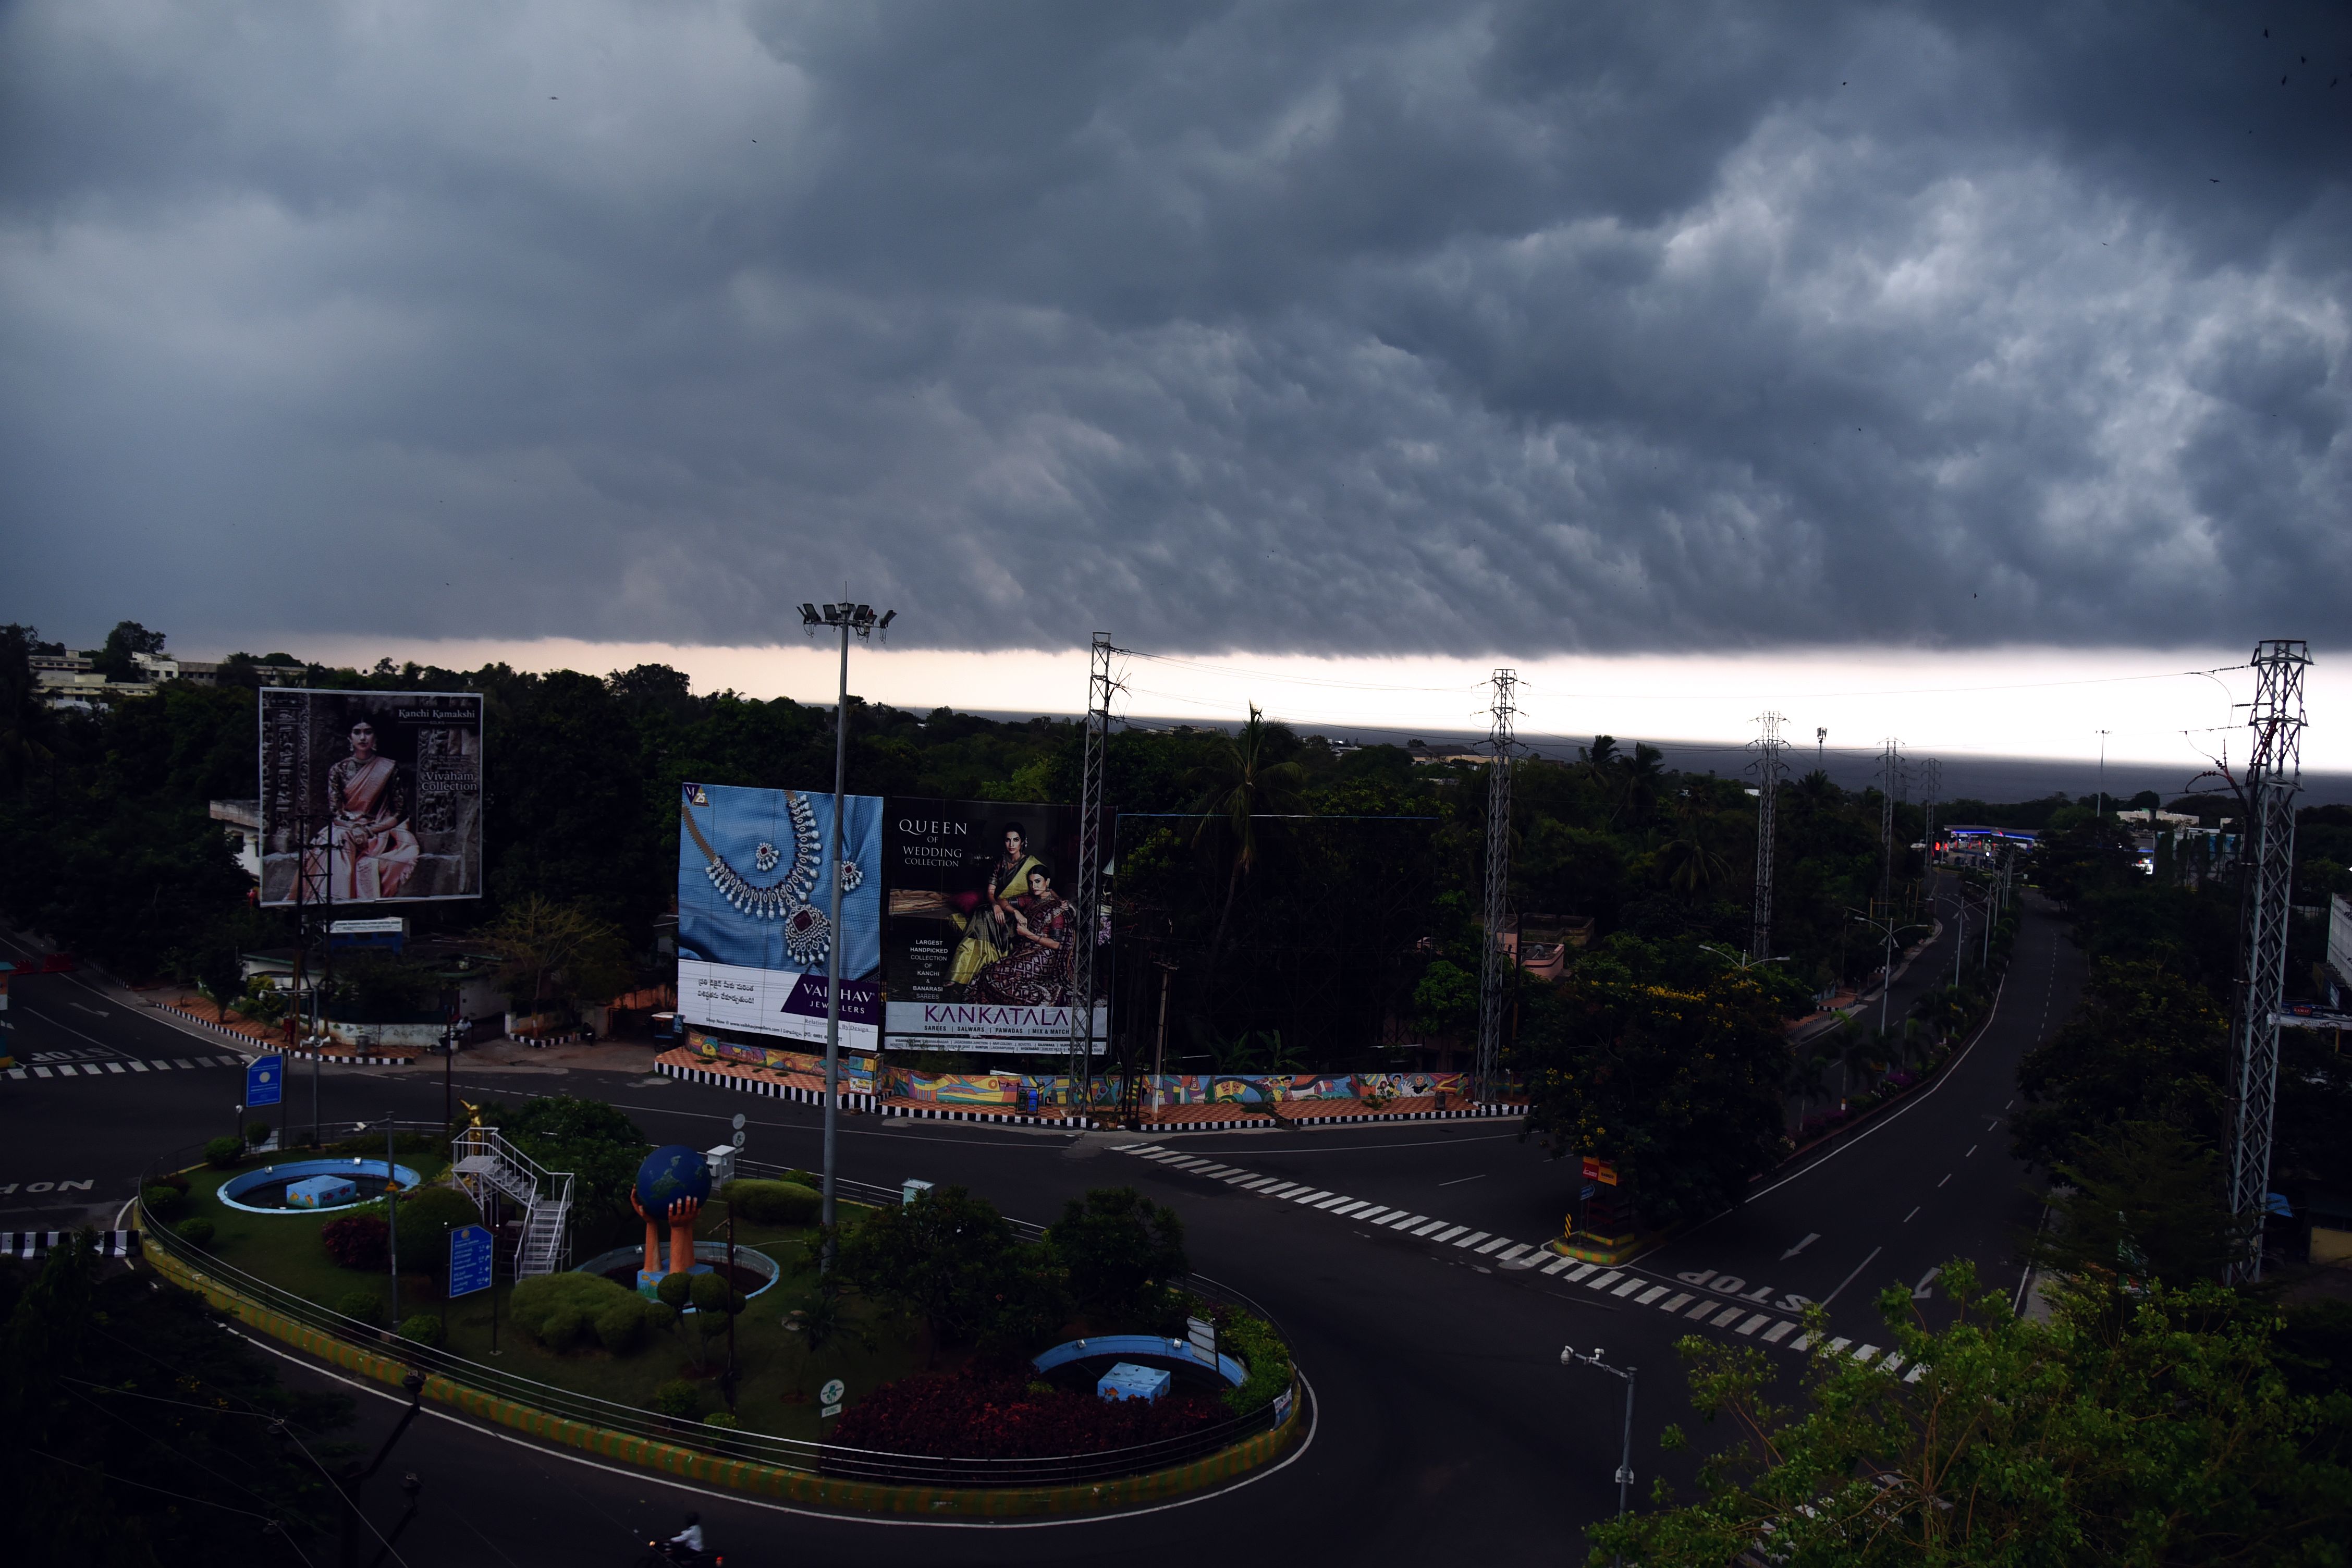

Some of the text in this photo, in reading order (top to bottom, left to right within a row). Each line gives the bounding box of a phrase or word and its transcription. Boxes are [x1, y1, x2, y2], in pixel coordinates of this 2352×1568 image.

[398, 709, 475, 719] Kanchi Kamakshi
[422, 782, 477, 791] Collection
[695, 793, 706, 803] 25
[899, 819, 967, 836] QUEEN
[903, 846, 962, 858] WEDDING
[904, 858, 959, 867] COLLECTION
[803, 983, 872, 1002] VAIHAV
[810, 1001, 865, 1014] JEWLERS
[925, 1005, 1069, 1026] KANKATALA
[31, 1048, 115, 1061] STOP
[1676, 1269, 1814, 1312] STOP
